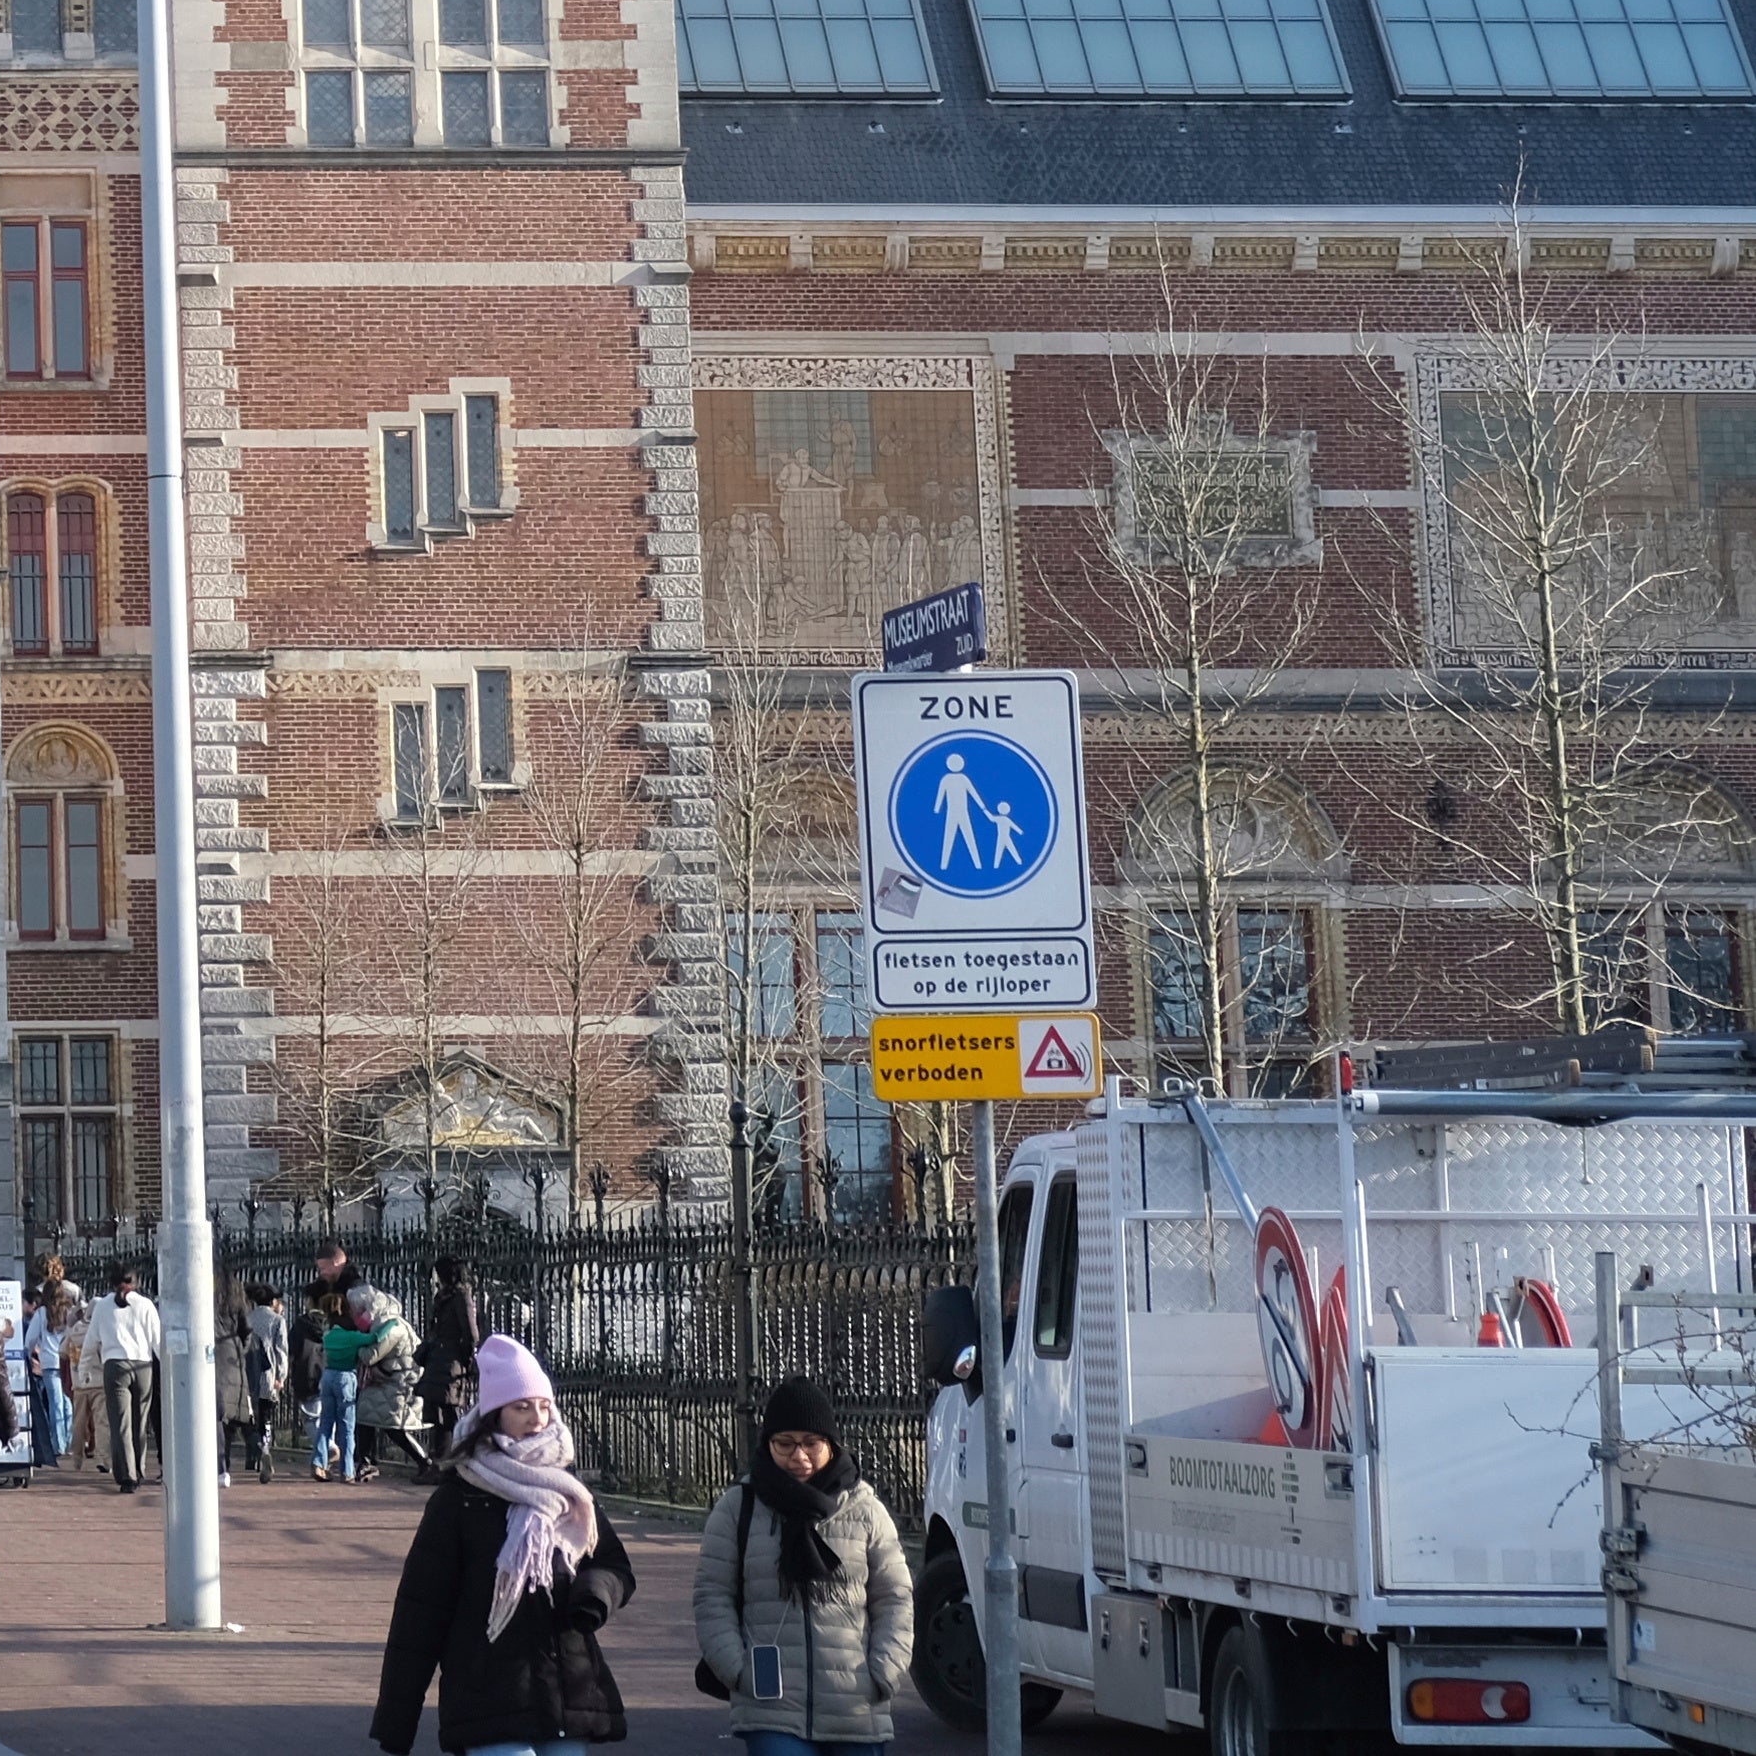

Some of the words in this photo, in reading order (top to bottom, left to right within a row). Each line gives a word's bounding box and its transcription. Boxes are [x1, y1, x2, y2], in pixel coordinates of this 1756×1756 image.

[884, 589, 969, 651] MUSEUMSTRAAT
[955, 632, 974, 655] ZUID
[919, 695, 1013, 720] ZONE
[885, 951, 956, 969] fietsen
[963, 950, 1079, 972] toegestaan
[913, 978, 937, 995] op
[945, 975, 968, 994] de
[975, 974, 1051, 997] rijloper
[879, 1033, 1015, 1052] snorfietsers
[880, 1063, 983, 1082] verboden
[1169, 1455, 1276, 1499] BOOMTOTAALZORG
